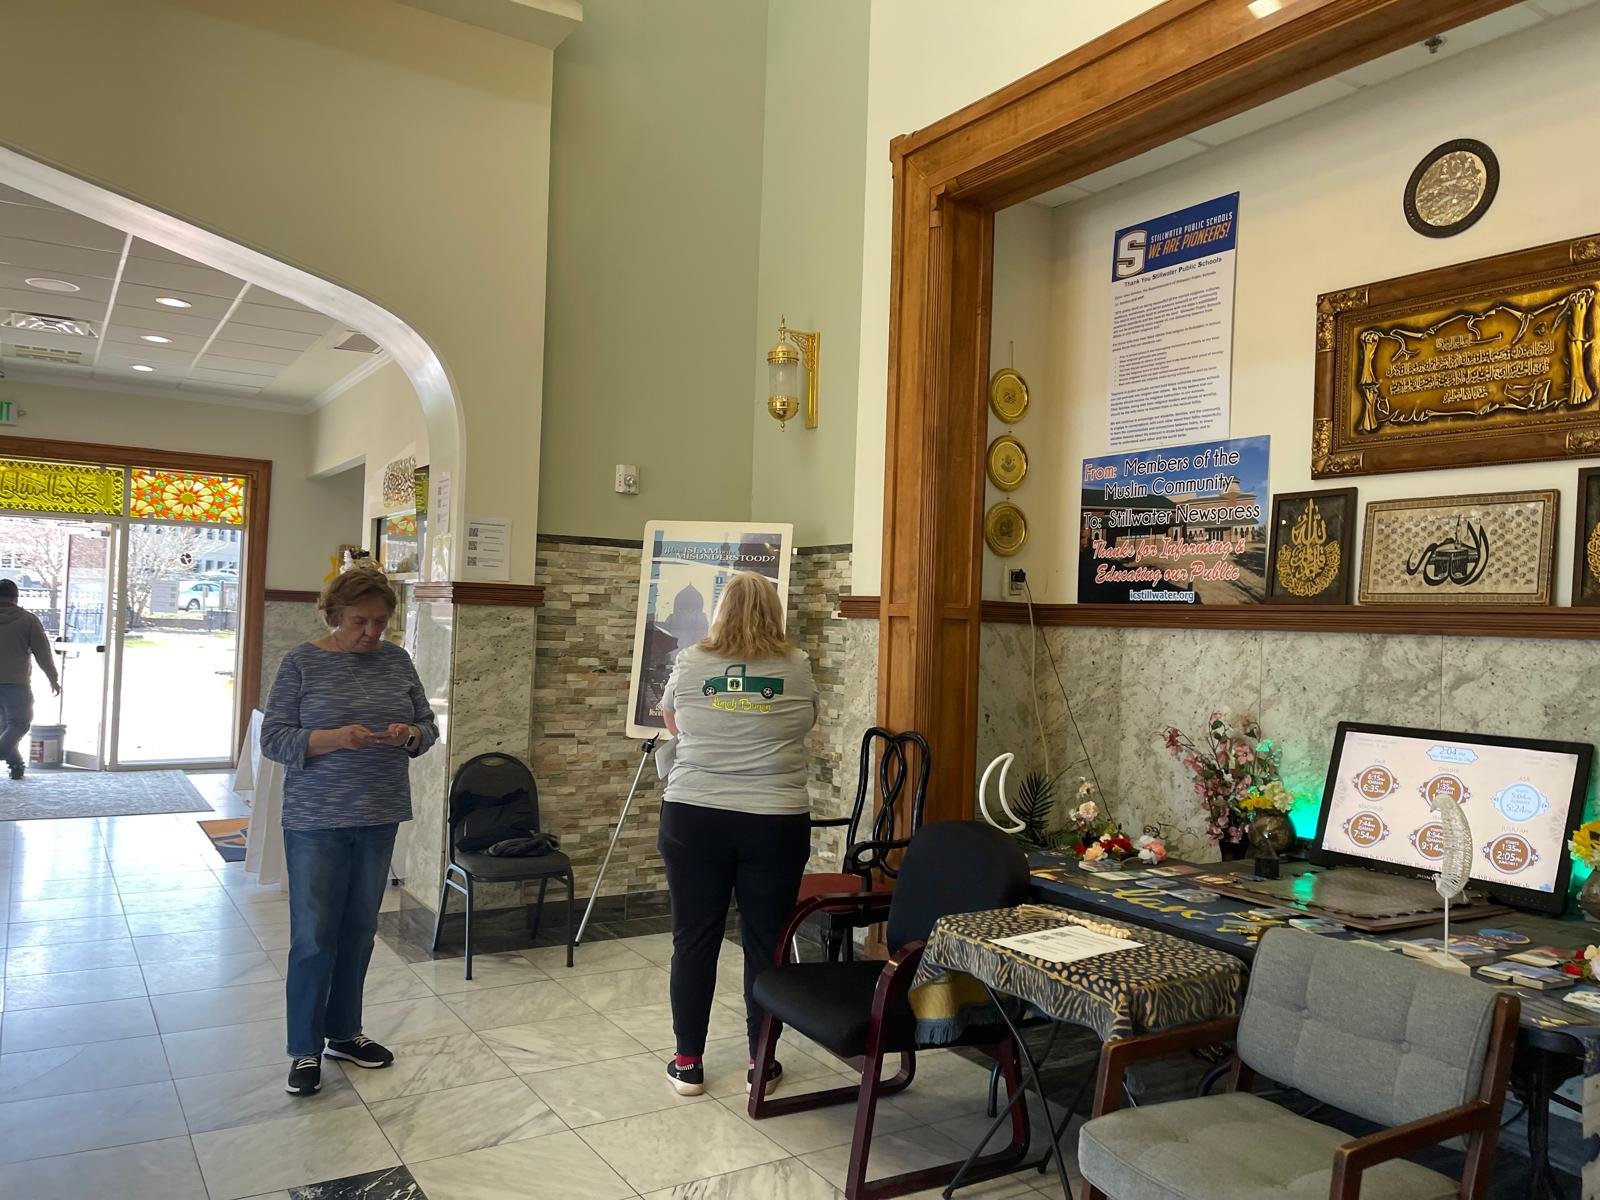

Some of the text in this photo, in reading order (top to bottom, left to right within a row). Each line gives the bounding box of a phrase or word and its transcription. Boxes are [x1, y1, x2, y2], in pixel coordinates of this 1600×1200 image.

[1149, 221, 1233, 258] WE ARE PIONEERS!
[1151, 211, 1233, 243] STILLWATER PUBLIC SCHOOLS
[1116, 229, 1147, 278] S
[1124, 279, 1140, 287] Thank
[1152, 269, 1178, 280] Stillwater
[1179, 264, 1197, 273] Public
[1198, 257, 1222, 268] Schools
[0, 400, 13, 422] IT
[1084, 446, 1240, 481] From: Members of the
[1104, 473, 1235, 500] Muslim Community
[1084, 503, 1260, 529] To: Stillwater Newspress
[676, 552, 776, 562] MISUNDERSTOOD?
[1093, 536, 1246, 562] Thanks for Informing &
[1095, 560, 1240, 587] Educating our Public
[1130, 590, 1195, 603] icstillwater.org
[1439, 745, 1456, 756] 2:04
